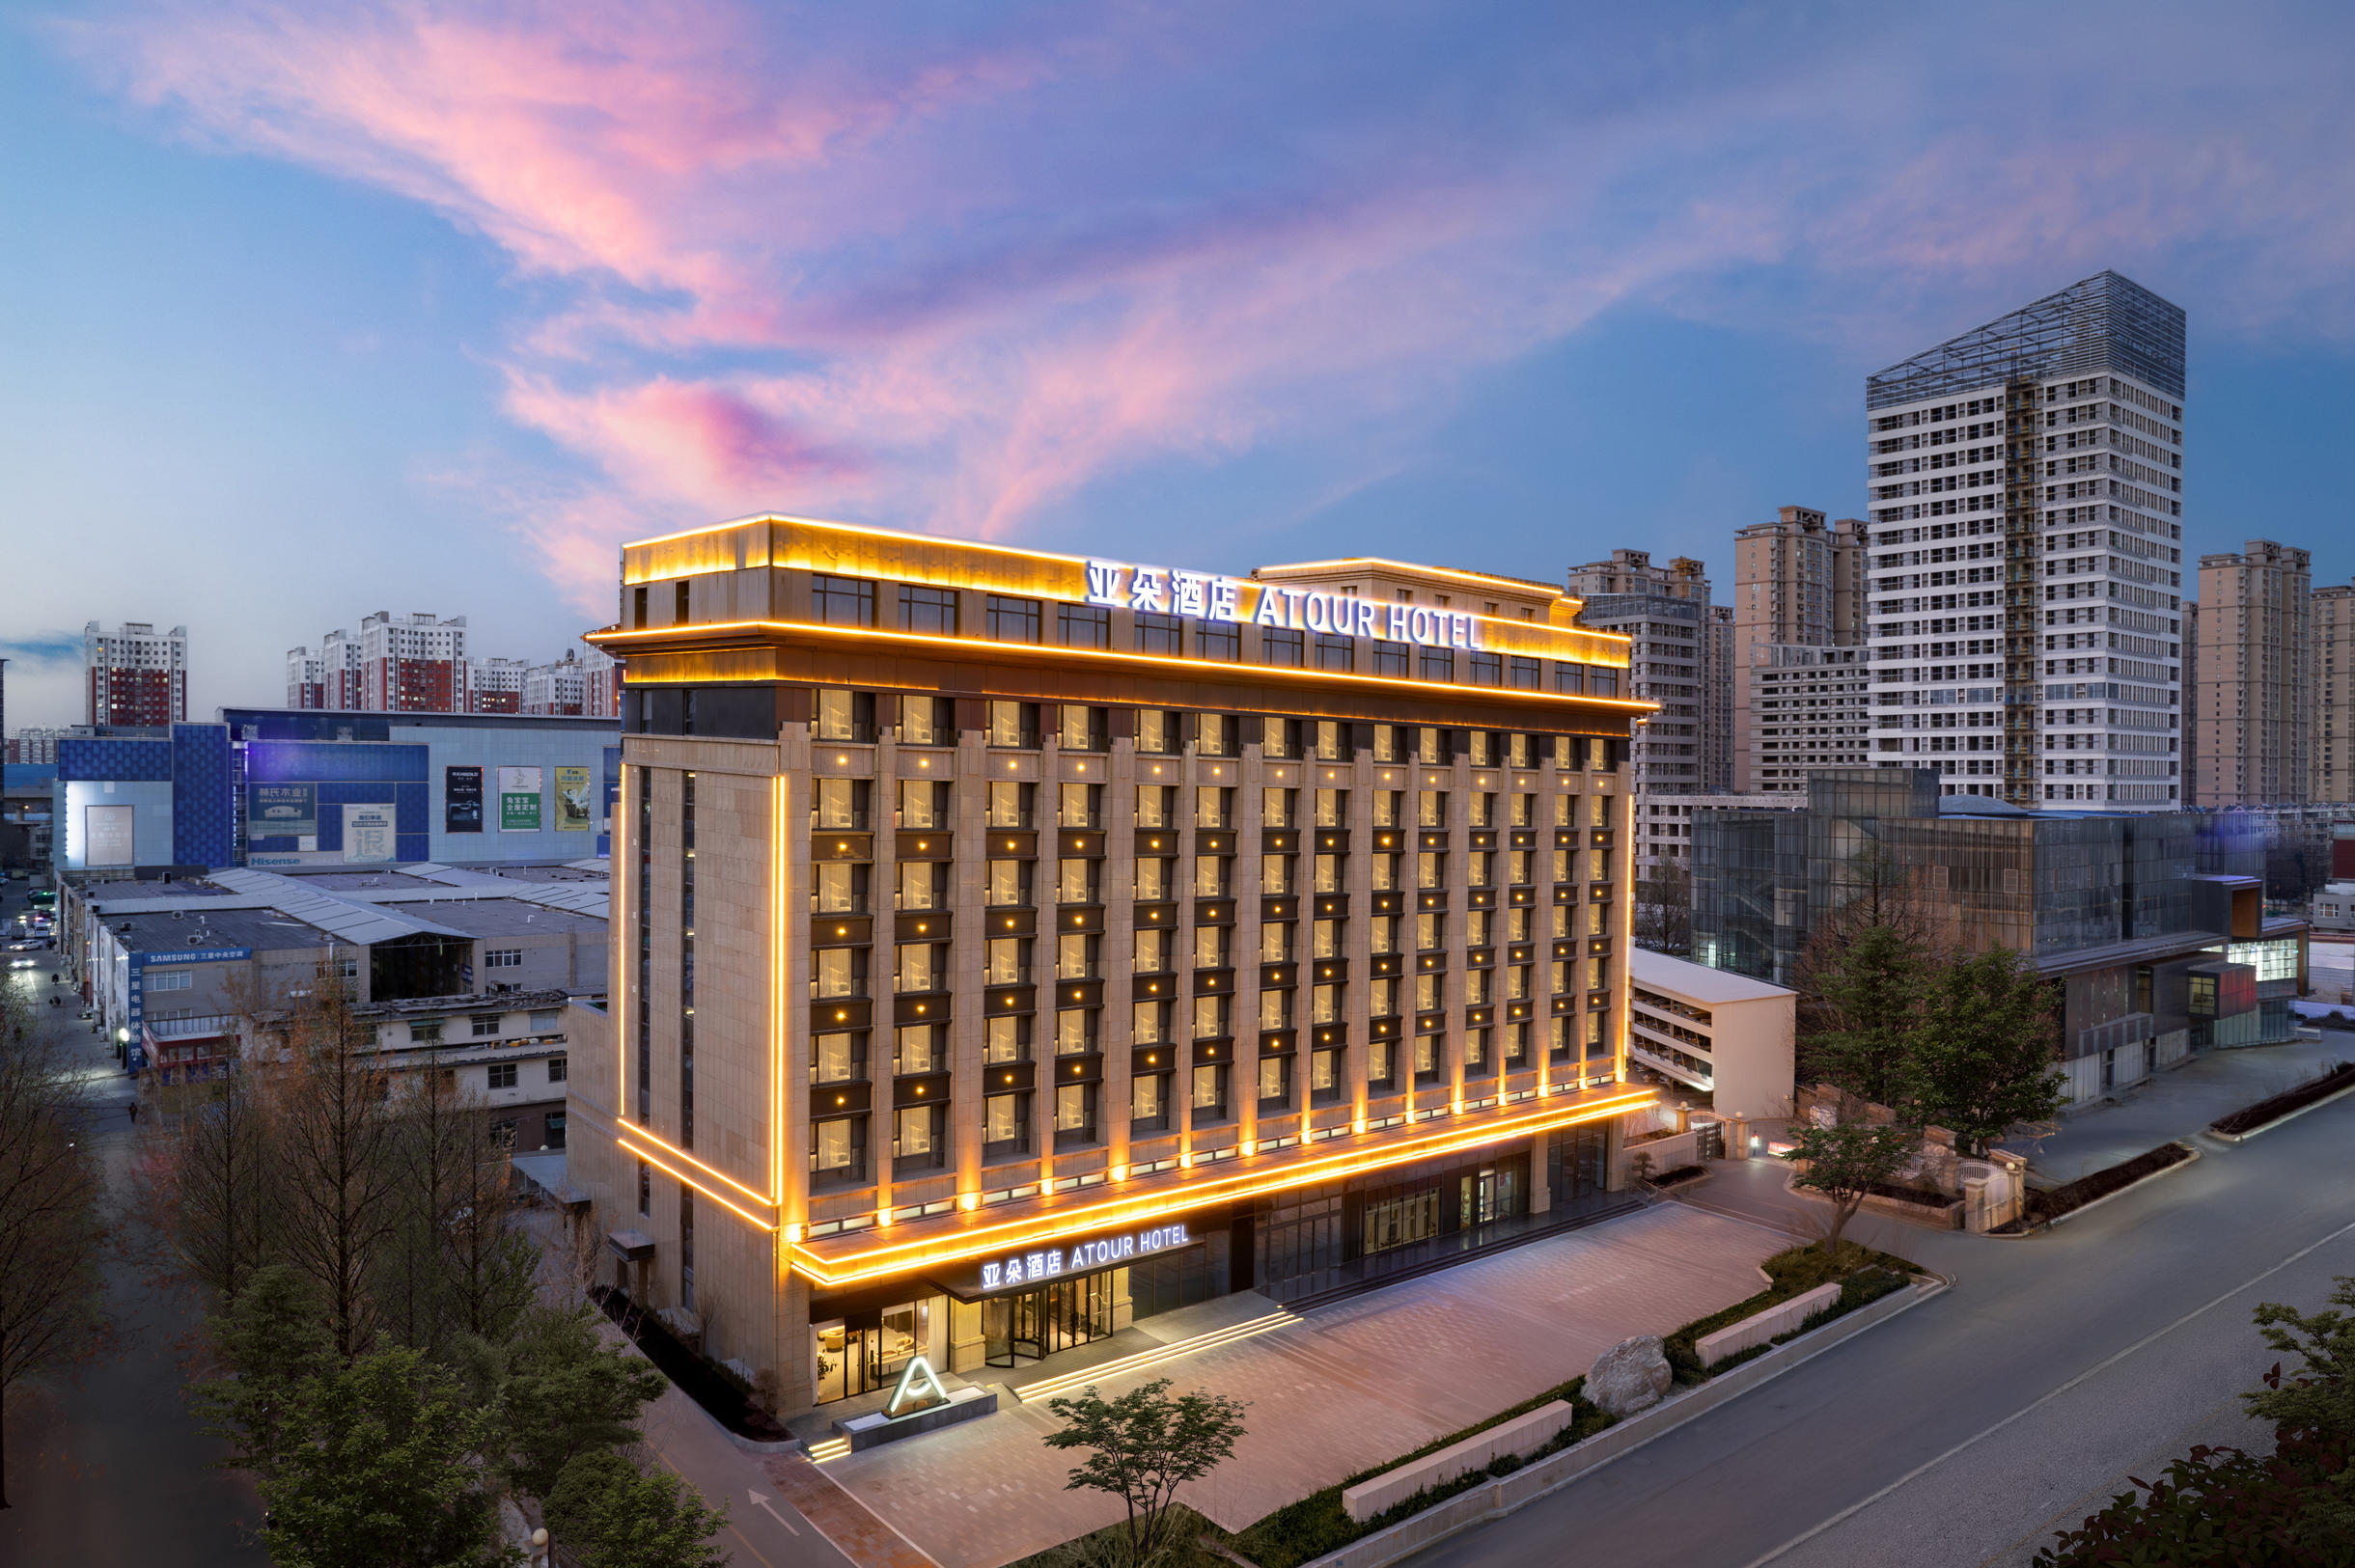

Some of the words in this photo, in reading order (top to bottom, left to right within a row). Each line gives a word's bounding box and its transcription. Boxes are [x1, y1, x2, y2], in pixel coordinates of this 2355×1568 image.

[1088, 561, 1235, 622] 亚朵酒店
[1256, 586, 1375, 637] ATOUR
[1389, 604, 1483, 649] HOTEL
[251, 857, 301, 866] Hisense
[150, 953, 197, 963] SAMSUNG
[1071, 1236, 1133, 1269] ATOUR
[1140, 1224, 1189, 1252] HOTEL
[982, 1250, 1062, 1289] 亚朵酒店
